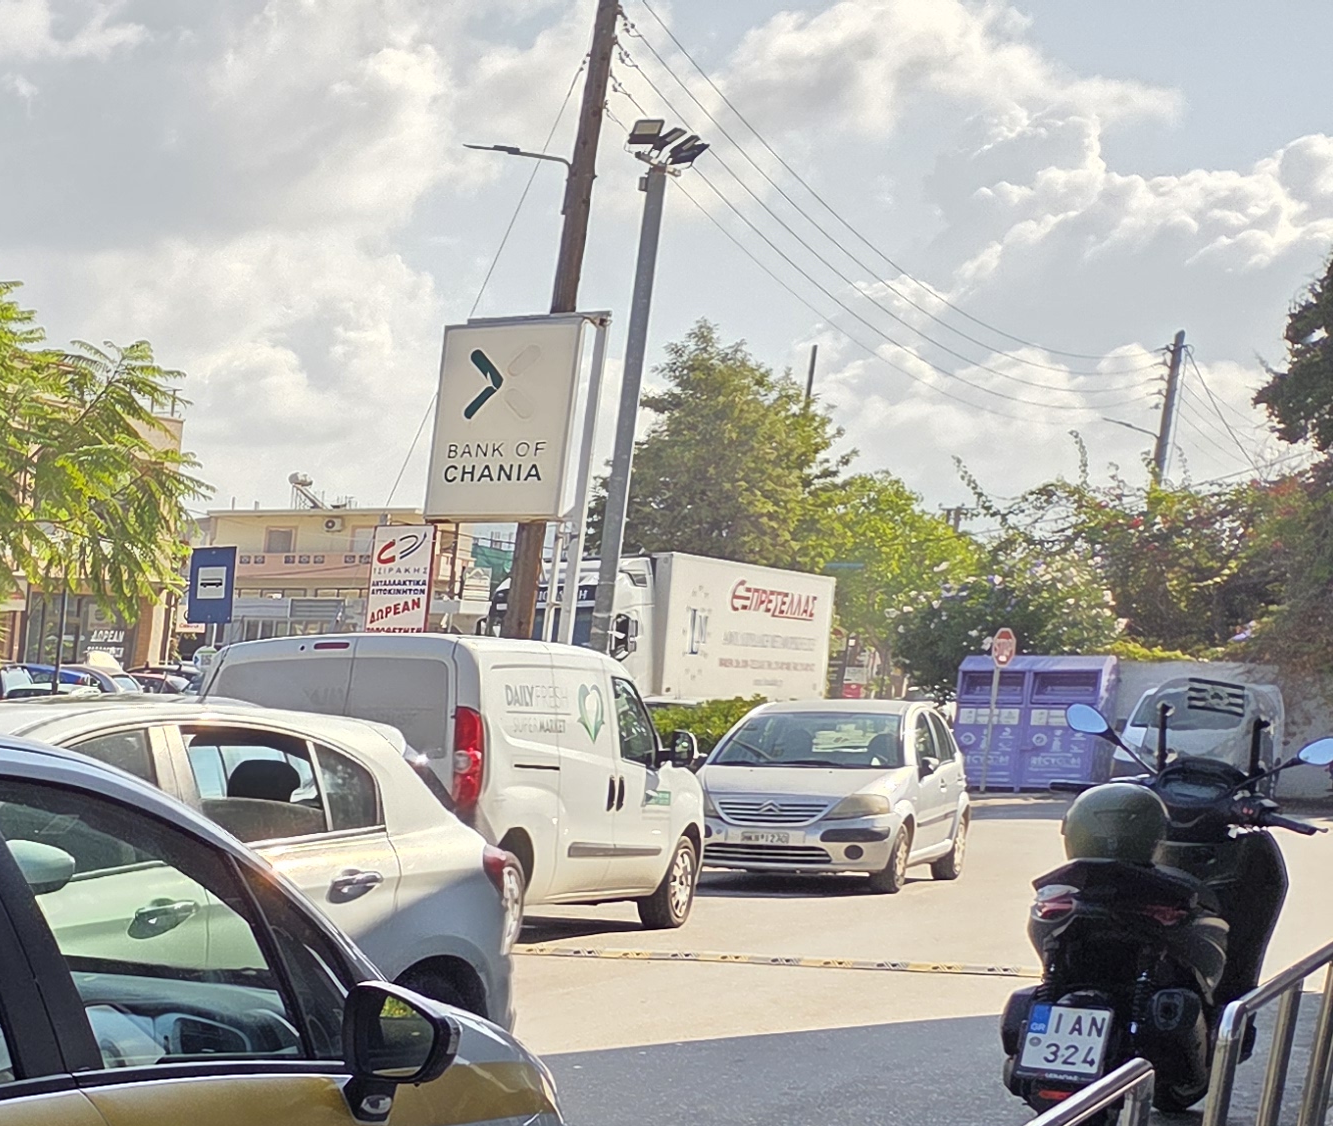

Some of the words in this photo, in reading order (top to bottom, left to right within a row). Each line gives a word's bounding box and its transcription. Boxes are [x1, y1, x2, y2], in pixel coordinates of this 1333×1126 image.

[447, 442, 504, 459] BANK
[515, 441, 547, 458] OF
[443, 463, 542, 483] CHANIA
[369, 597, 421, 624] ΔΩΡΕΑΝ
[1030, 1022, 1047, 1031] GR
[1054, 1013, 1106, 1038] IAN
[1043, 1043, 1096, 1067] 324
